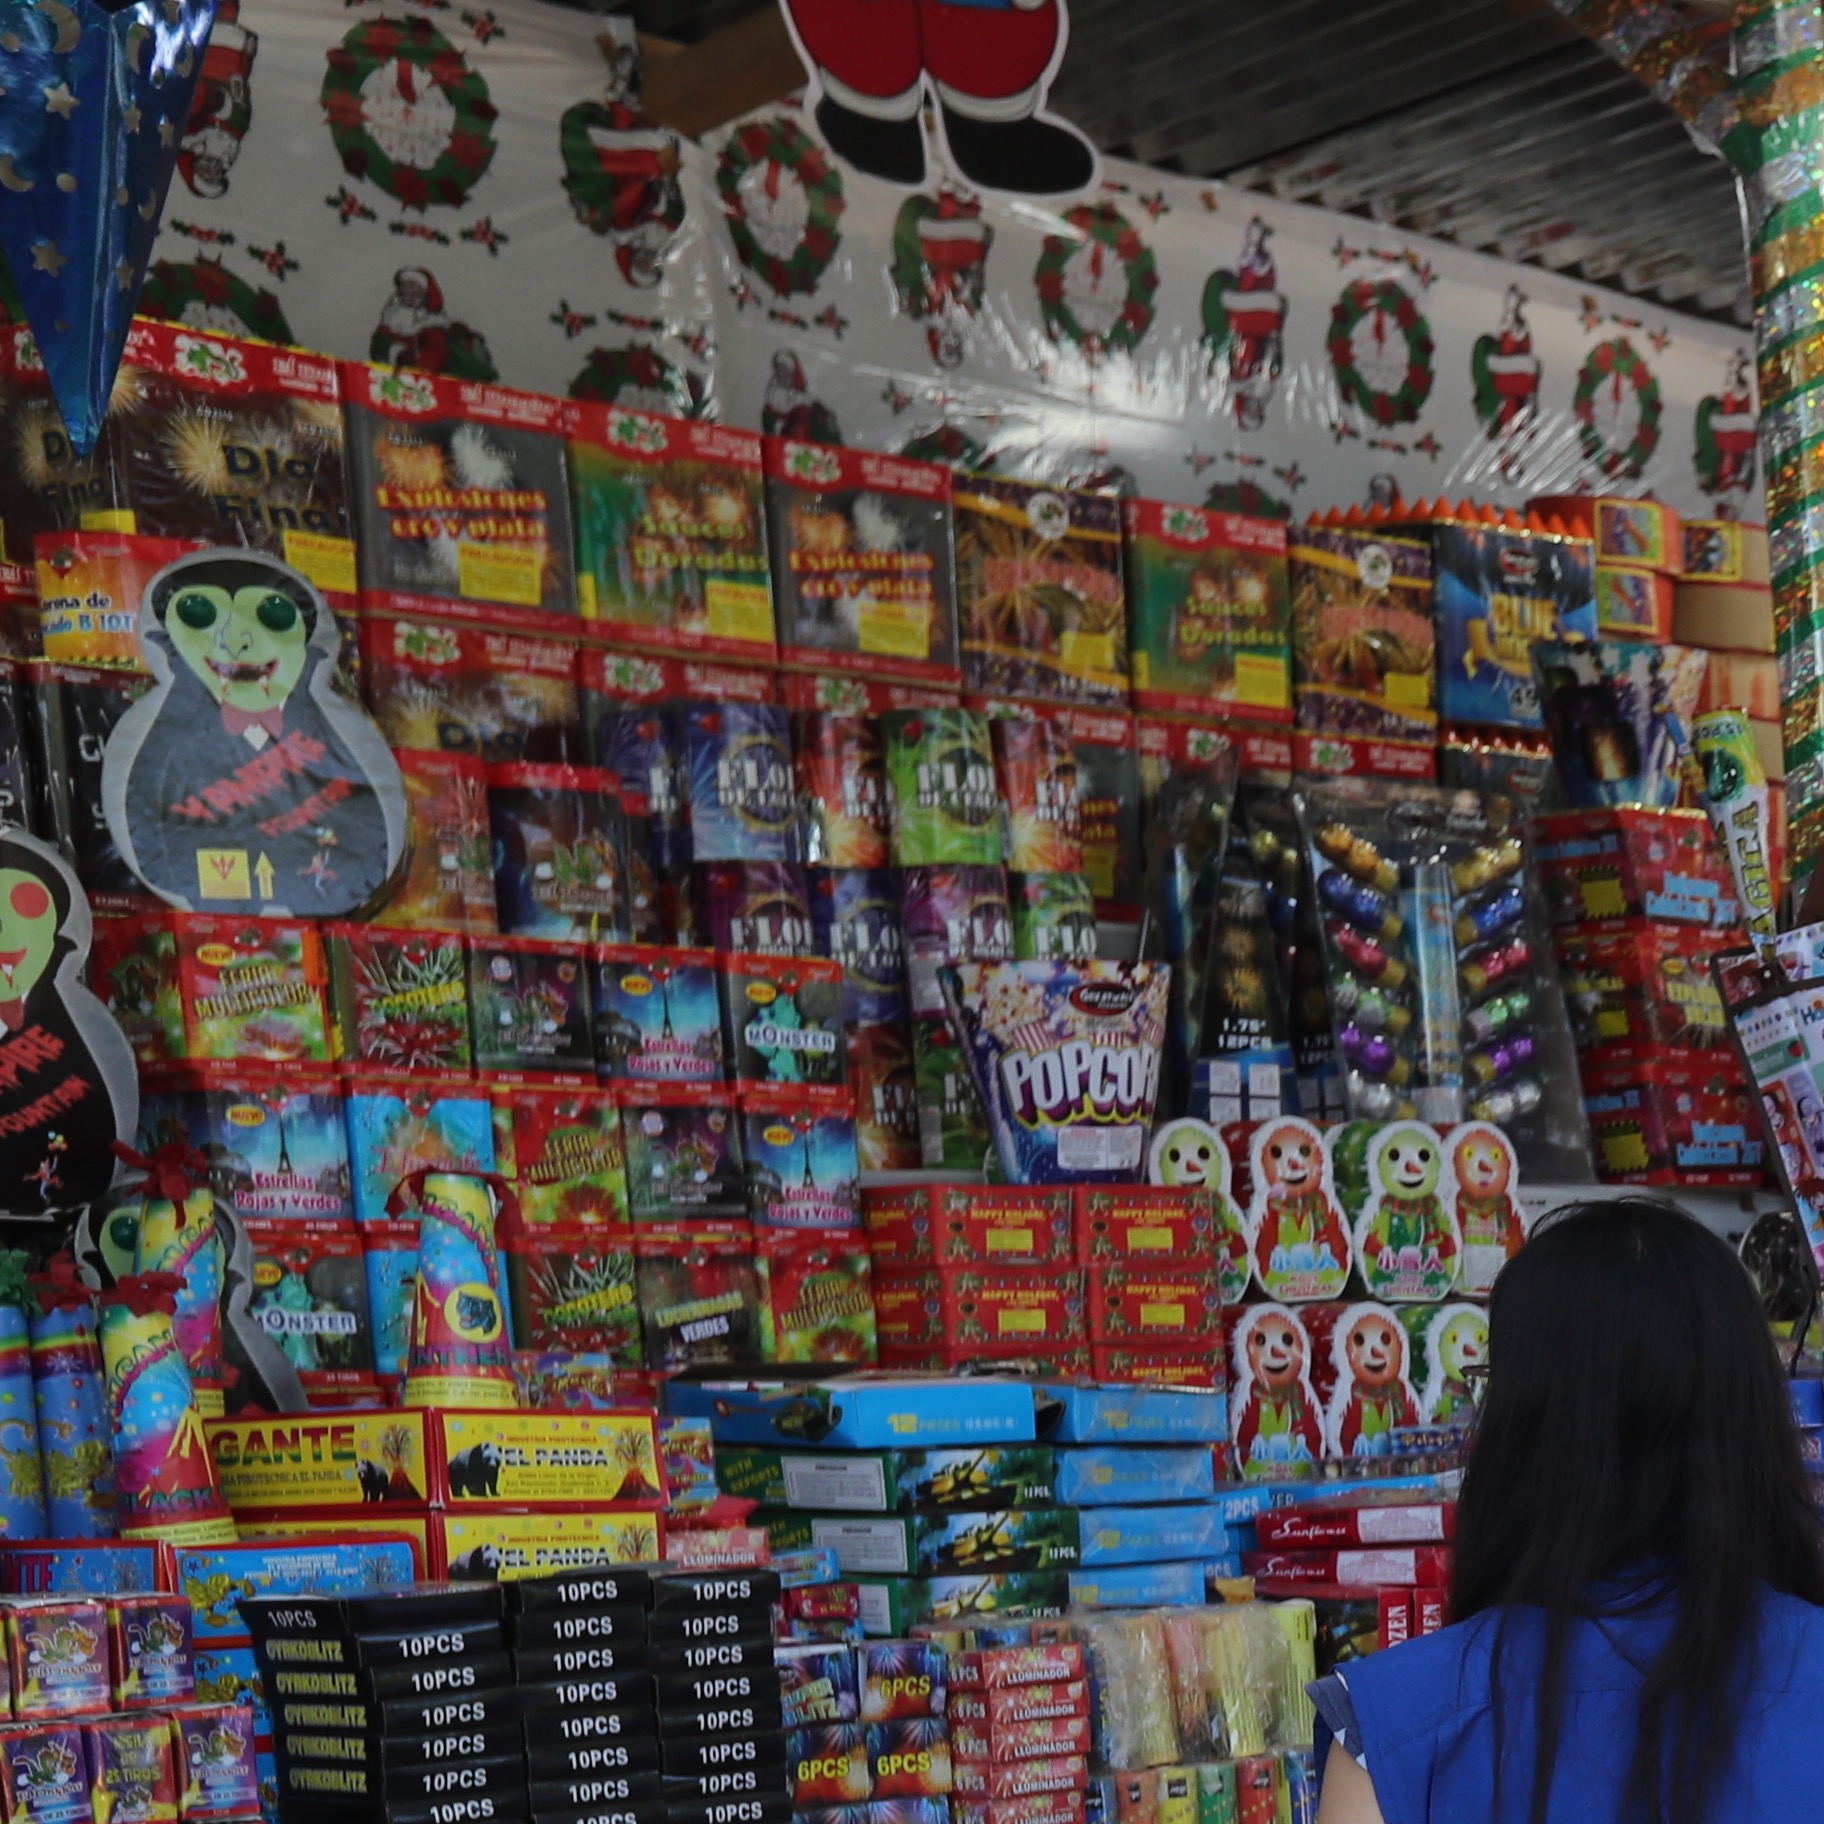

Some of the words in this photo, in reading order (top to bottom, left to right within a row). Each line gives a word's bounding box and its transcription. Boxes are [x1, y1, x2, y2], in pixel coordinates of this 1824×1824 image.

[209, 1424, 357, 1466] GANTE
[503, 1449, 531, 1468] EL
[535, 1447, 609, 1468] PANDA
[502, 1546, 531, 1568] EL
[536, 1547, 611, 1567] PANDA
[558, 1581, 617, 1602] 10PCS
[693, 1580, 750, 1600] 10PCS
[268, 1610, 318, 1628] 10PCS
[554, 1617, 612, 1638] 10PCS
[683, 1615, 738, 1636] 10PCS
[399, 1633, 464, 1657] 10PCS
[685, 1645, 742, 1666] 10PCS
[554, 1649, 613, 1671] 10PCS
[412, 1667, 475, 1691] 10PCS
[694, 1678, 750, 1698] 10PCS
[880, 1675, 931, 1698] 6PCS
[557, 1682, 616, 1703] 10PCS
[423, 1702, 484, 1726] 10PCS
[697, 1709, 753, 1730] 10PCS
[561, 1715, 620, 1737] 10PCS
[423, 1734, 484, 1758] 10PCS
[700, 1742, 755, 1763] 10PCS
[569, 1748, 628, 1769] 10PCS
[797, 1755, 850, 1782] 6PCS
[877, 1752, 931, 1776] 6PCS
[423, 1769, 486, 1792] 10PCS
[569, 1780, 628, 1802] 10PCS
[700, 1772, 756, 1793] 10PCS
[431, 1799, 494, 1823] 10PCS
[706, 1802, 762, 1823] 10PCS
